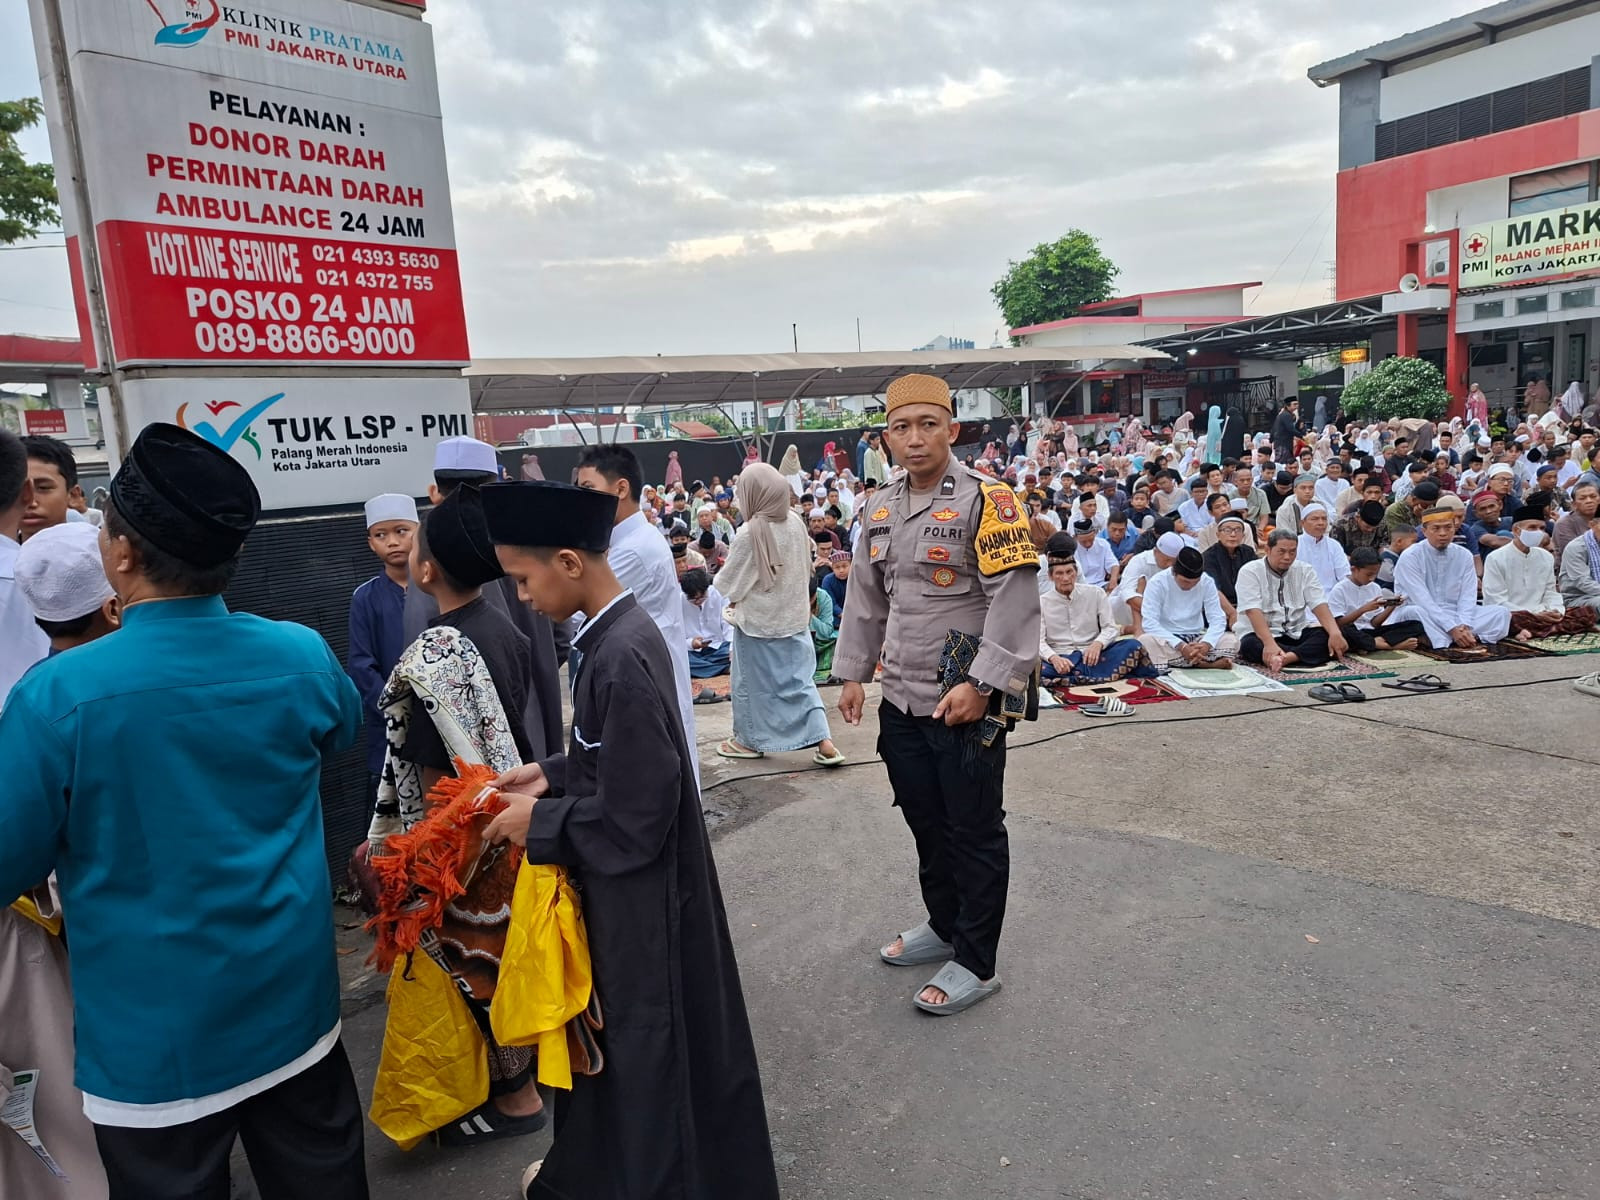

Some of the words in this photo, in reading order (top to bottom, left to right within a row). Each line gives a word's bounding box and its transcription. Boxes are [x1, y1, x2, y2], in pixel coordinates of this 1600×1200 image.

[185, 11, 203, 20] PMI
[221, 6, 304, 39] KLINIK
[308, 26, 404, 62] PRATAMA
[224, 28, 260, 50] PMI
[265, 38, 348, 68] JAKARTA
[352, 57, 407, 80] UTARA
[209, 89, 352, 135] PELAYANAN
[188, 121, 291, 159] DONOR
[299, 139, 386, 172] DARAH
[146, 152, 334, 199] PERMINTAAN
[341, 178, 425, 209] DARAH
[155, 191, 333, 231] AMBULANCE
[339, 210, 370, 235] 24
[377, 213, 425, 239] JAM
[1506, 207, 1600, 248] MARK
[145, 230, 230, 281] HOTLINE
[228, 236, 304, 285] SERVICE
[312, 244, 346, 264] 021
[351, 248, 395, 268] 4393
[399, 251, 440, 271] 5630
[1462, 260, 1489, 274] PMI
[1494, 248, 1542, 264] PALANG
[1545, 239, 1590, 256] MERAH
[315, 268, 349, 288] 021
[355, 270, 399, 291] 4372
[402, 273, 434, 292] 755
[1495, 264, 1532, 277] KOTA
[186, 286, 301, 322] POSKO
[311, 293, 348, 324] 24
[355, 296, 415, 325] JAM
[194, 321, 416, 355] 089-8866-9000
[267, 415, 337, 444] TUK
[345, 414, 397, 440] LSP
[421, 413, 469, 439] PMI
[271, 446, 313, 461] Palang
[315, 443, 351, 459] Merah
[353, 441, 408, 456] Indonesia
[273, 460, 302, 472] Kota
[304, 457, 347, 471] Jakarta
[351, 455, 381, 468] Utara
[923, 526, 962, 539] POLRI
